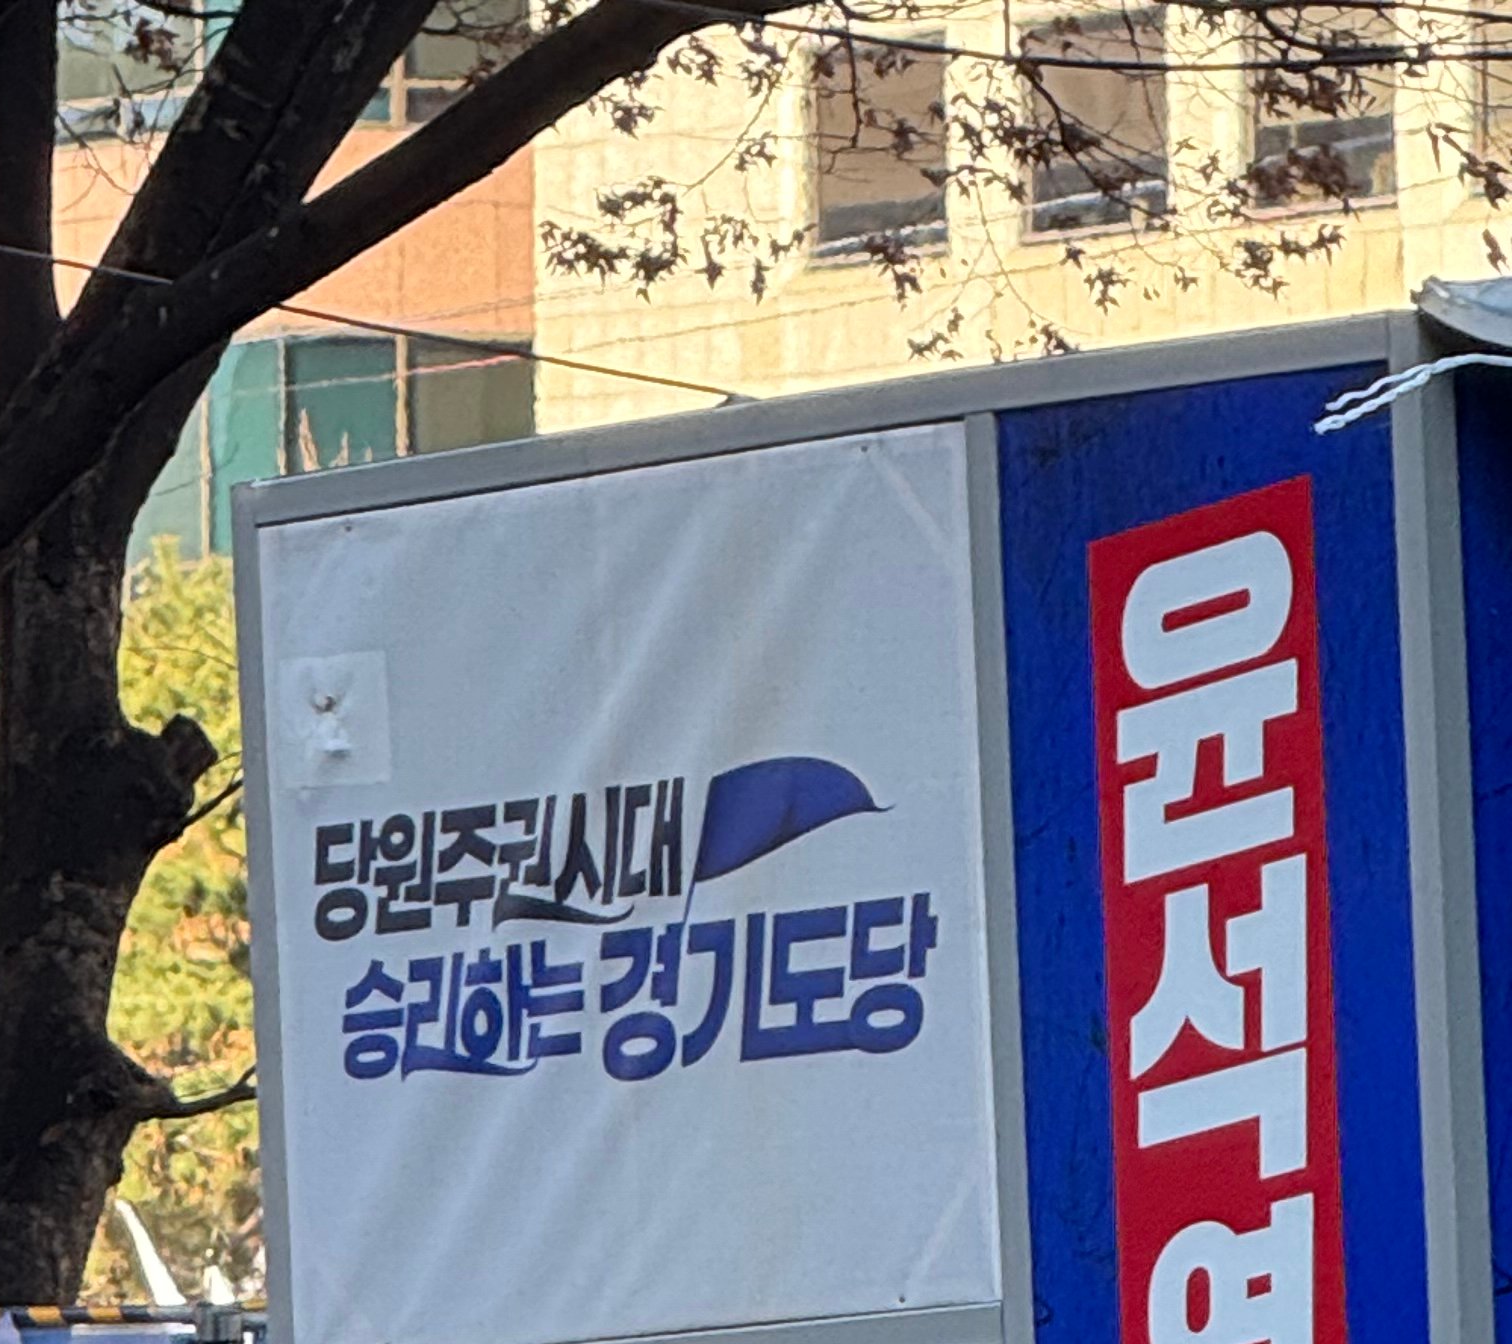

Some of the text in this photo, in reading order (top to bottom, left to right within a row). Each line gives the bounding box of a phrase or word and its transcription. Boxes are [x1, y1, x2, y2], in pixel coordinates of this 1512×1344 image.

[314, 777, 686, 942] 당원주권시대
[342, 892, 939, 1082] 승리하는 경기도당
